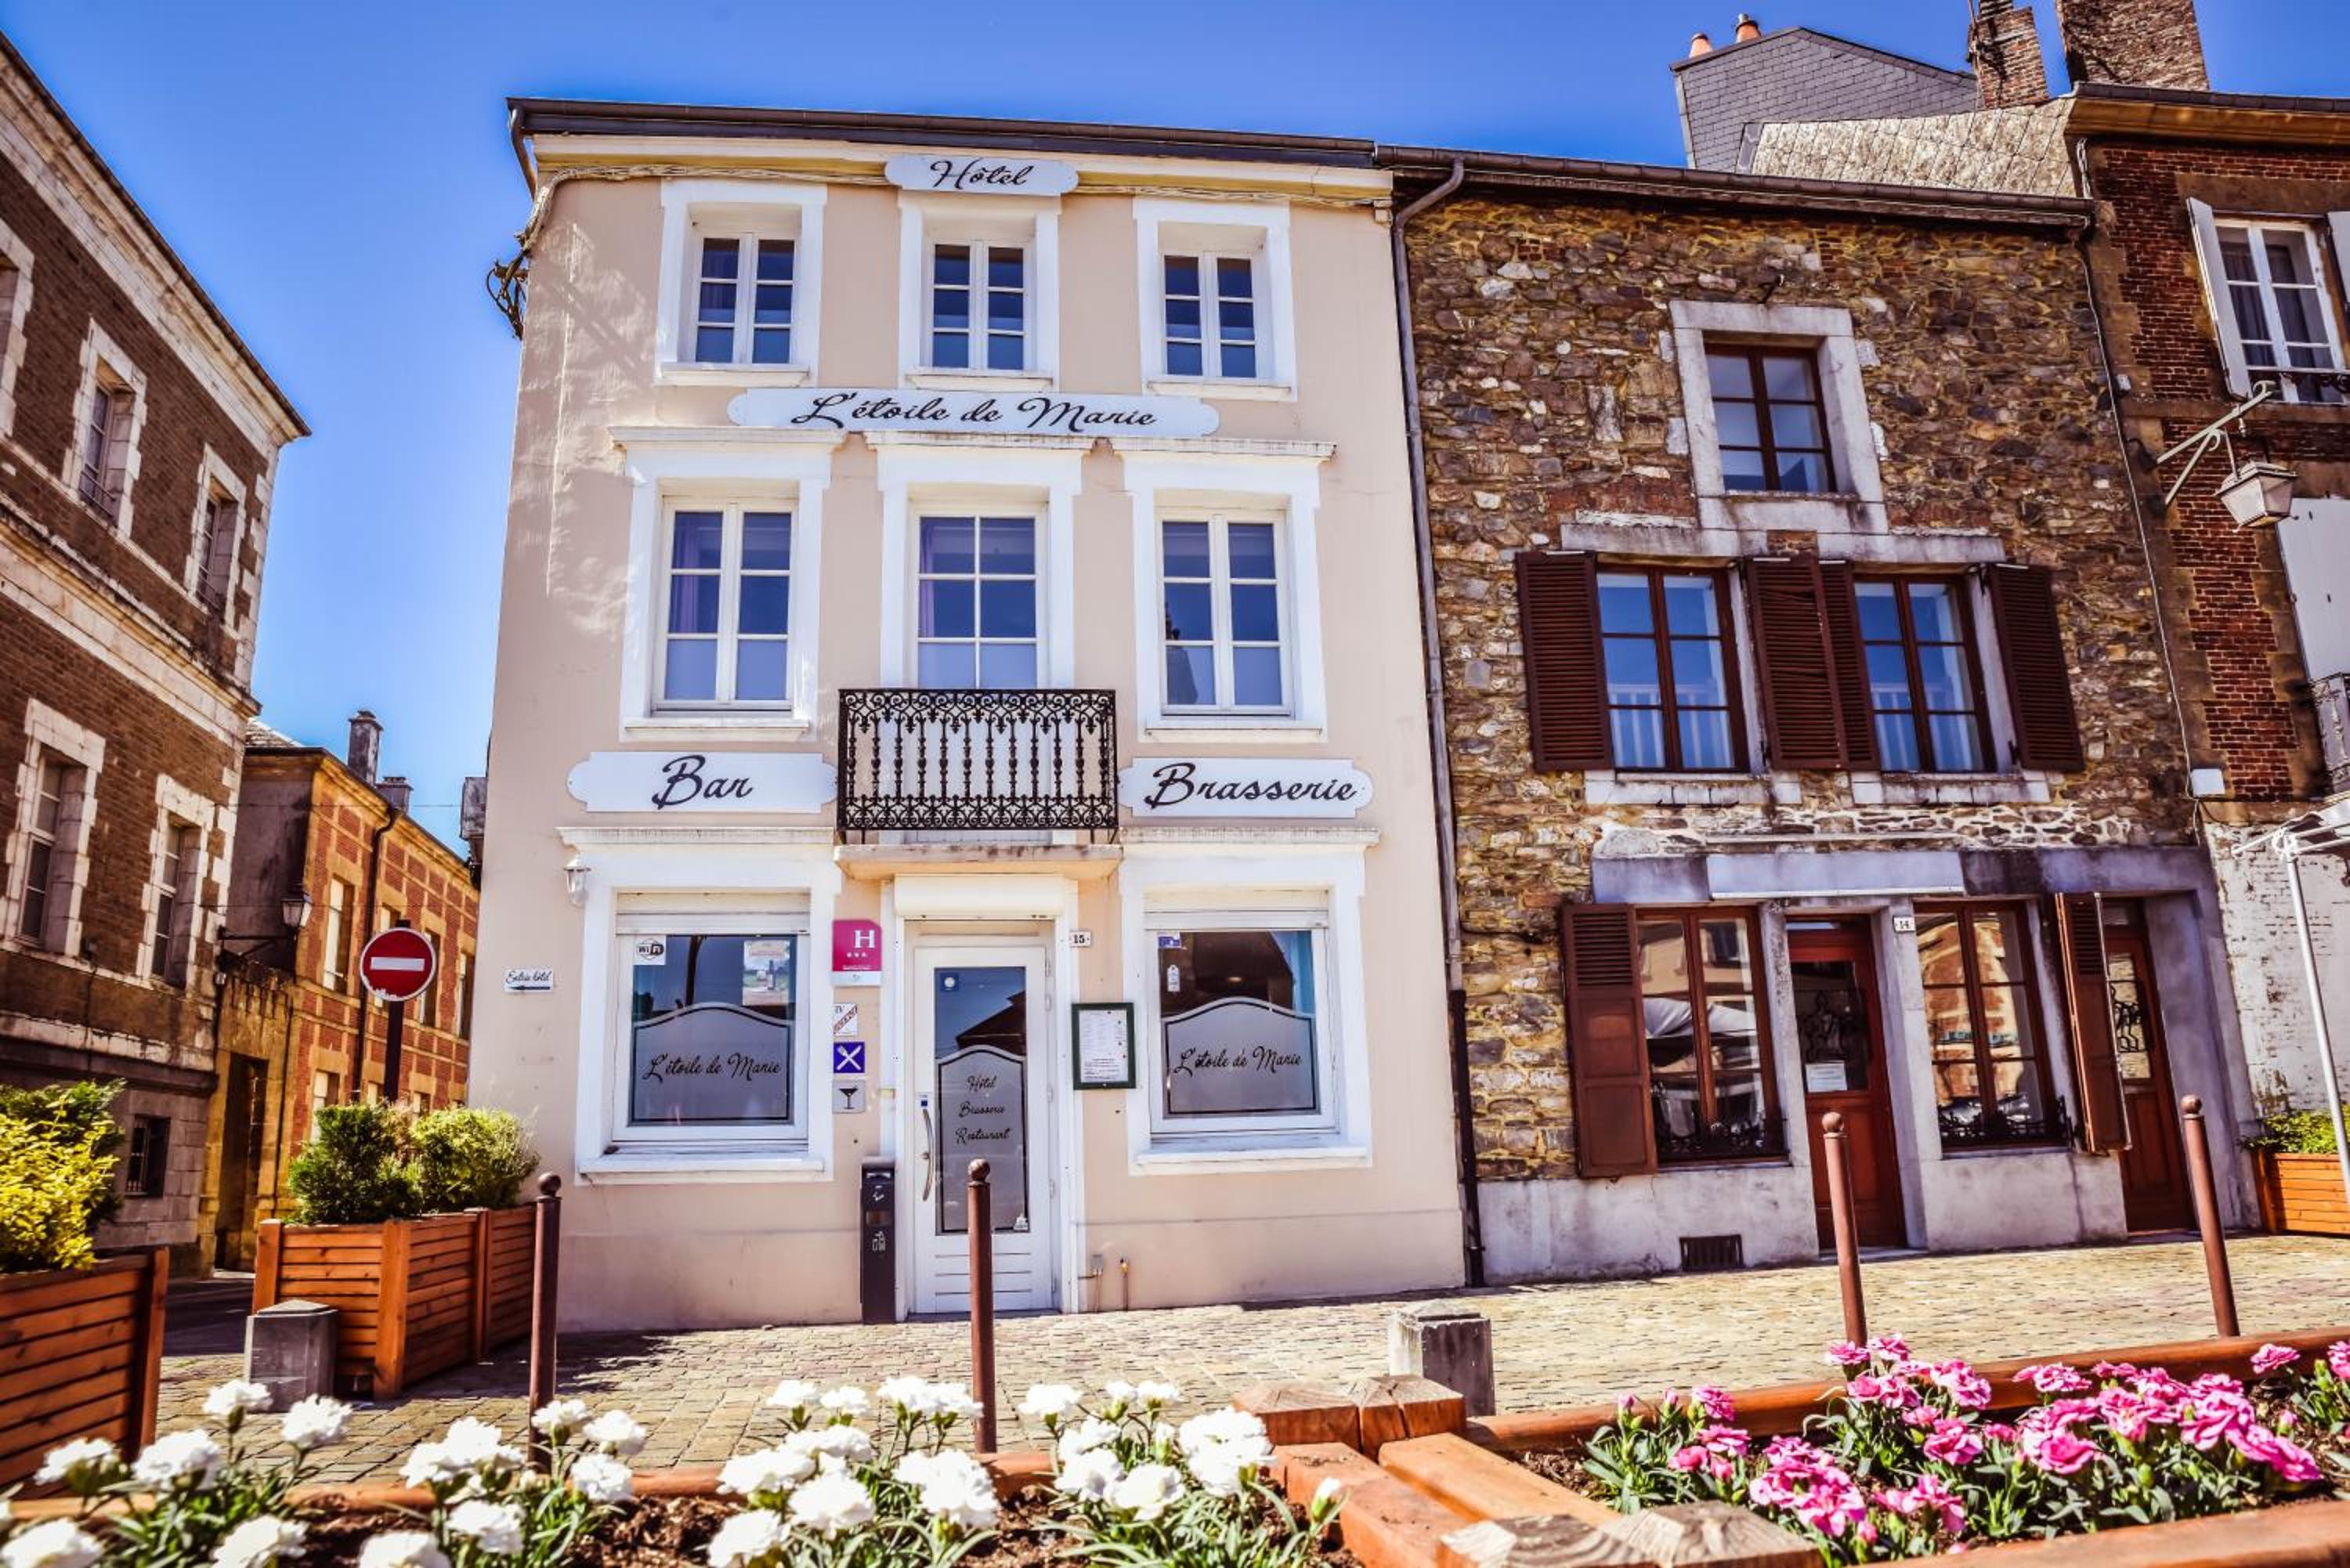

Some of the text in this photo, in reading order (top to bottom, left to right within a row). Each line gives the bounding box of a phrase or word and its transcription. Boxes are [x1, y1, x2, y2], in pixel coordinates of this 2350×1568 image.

[929, 159, 1035, 190] Hôtel
[790, 392, 1158, 432] L'étoile de Marie
[652, 754, 753, 810] Bar
[1144, 762, 1358, 809] Brasserie
[854, 930, 875, 948] H
[1074, 934, 1085, 943] 15
[642, 1053, 781, 1083] L'étoile de Marie
[1173, 1046, 1303, 1078] L'étoile de Marie
[956, 1127, 1010, 1143] Restaurant
